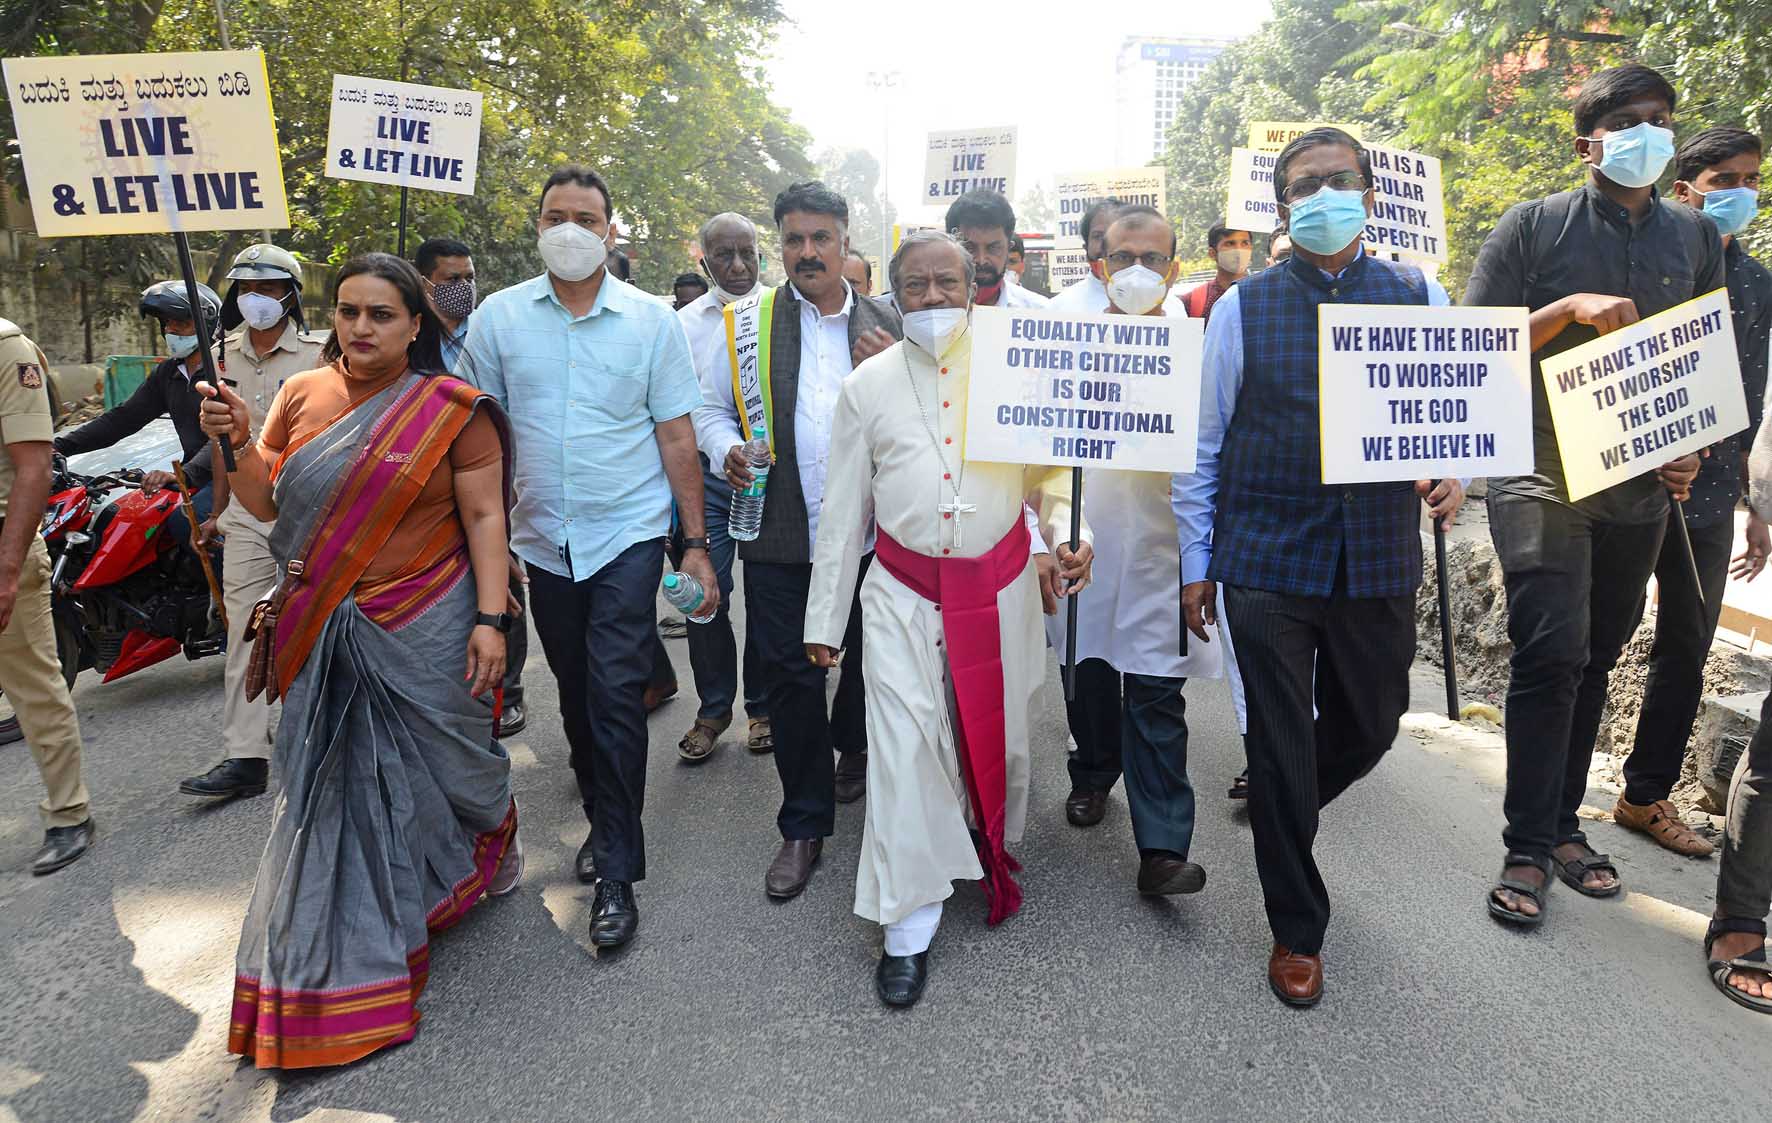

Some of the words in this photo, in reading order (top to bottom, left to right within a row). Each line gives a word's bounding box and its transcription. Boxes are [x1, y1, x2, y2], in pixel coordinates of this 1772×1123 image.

[19, 76, 71, 104] ಬದುಕಿ
[80, 73, 129, 112] ಮತ್ತು
[135, 70, 208, 99] ಬದುಕಲು
[218, 71, 251, 97] ಬಿಡಿ
[100, 116, 193, 157] LIVE
[377, 116, 430, 145] LIVE
[1266, 130, 1284, 143] WE
[339, 149, 357, 168] &
[363, 148, 405, 173] LET
[409, 154, 463, 181] LIVE
[953, 154, 986, 171] LIVE
[1253, 155, 1276, 169] EQU
[1369, 149, 1390, 170] IA
[1394, 155, 1411, 175] IS
[1416, 160, 1426, 178] A
[929, 183, 940, 196] &
[944, 178, 968, 196] LET
[1250, 170, 1273, 183] OTH
[1372, 175, 1424, 202] CULAR
[53, 183, 85, 216] &
[93, 175, 159, 214] LET
[173, 171, 264, 211] LIVE
[1245, 201, 1276, 214] CONS
[1373, 201, 1430, 228] UNTRY.
[1059, 220, 1079, 236] TH
[1423, 236, 1438, 254] IT
[1052, 266, 1078, 276] CITIZENS
[1011, 318, 1109, 344] EQUALITY
[1114, 324, 1170, 346] WITH
[1332, 326, 1362, 352] WE
[1369, 326, 1418, 352] HAVE
[1421, 327, 1457, 352] THE
[1462, 327, 1520, 352] RIGHT
[736, 342, 758, 356] NPP
[1007, 347, 1073, 370] OTHER
[1079, 351, 1171, 376] CITIZENS
[1557, 366, 1587, 394] WE
[1590, 349, 1636, 382] HAVE
[1636, 333, 1670, 363] THE
[1672, 309, 1723, 350] RIGHT
[1366, 363, 1390, 388] TO
[1396, 363, 1488, 388] WORSHIP
[1592, 386, 1617, 411] TO
[1619, 350, 1701, 404] WORSHIP
[1052, 379, 1073, 399] IS
[1079, 380, 1121, 402] OUR
[997, 405, 1174, 434] CONSTITUTIONAL
[1388, 399, 1423, 425] THE
[1428, 399, 1467, 424] GOD
[1617, 404, 1652, 433] THE
[1654, 387, 1690, 419] GOD
[1052, 437, 1116, 460] RIGHT
[1362, 436, 1393, 461] WE
[1399, 434, 1471, 460] BELIEVE
[1475, 433, 1495, 458] IN
[1600, 443, 1630, 471] WE
[1632, 413, 1698, 458] BELIEVE
[1699, 405, 1718, 429] IN
